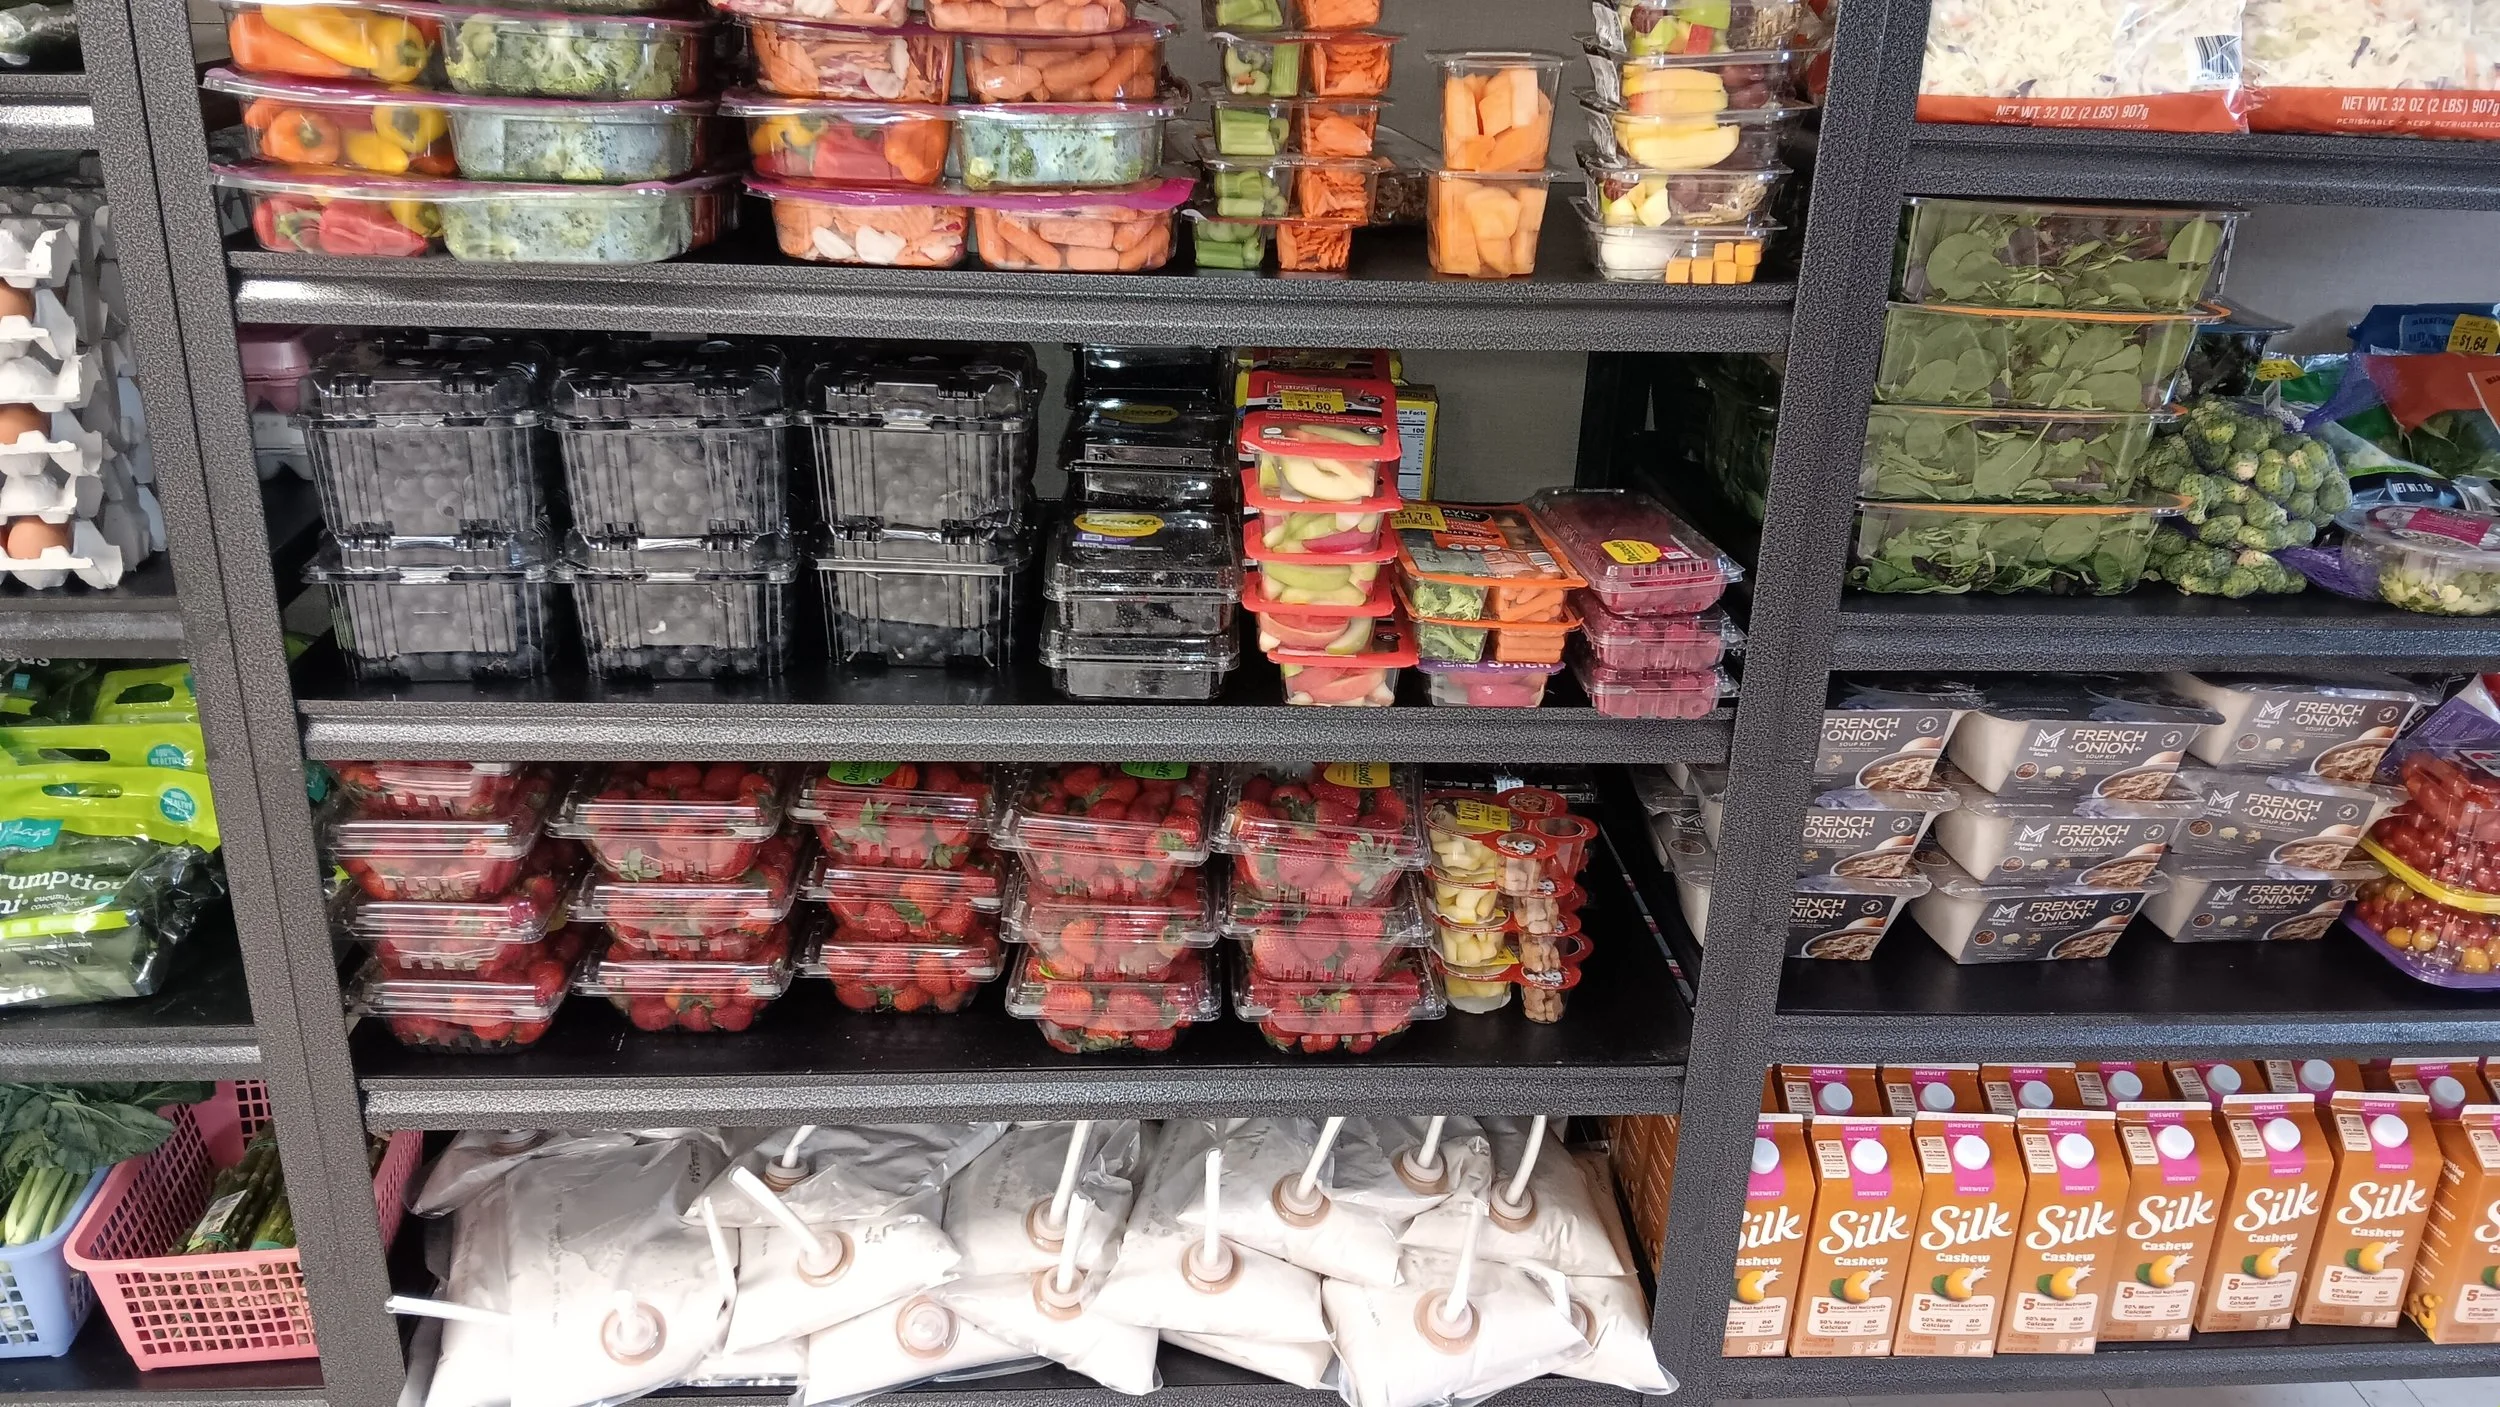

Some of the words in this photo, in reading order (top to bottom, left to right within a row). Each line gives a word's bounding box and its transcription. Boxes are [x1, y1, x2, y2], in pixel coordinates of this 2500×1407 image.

[1995, 105, 2019, 116] NET
[2020, 105, 2041, 119] WT.
[2043, 105, 2058, 119] 32
[2060, 106, 2077, 119] OZ
[2078, 105, 2093, 120] (2
[2093, 105, 2119, 120] LBS)
[2121, 104, 2149, 120] 907g
[2341, 95, 2365, 111] NET
[2367, 97, 2387, 112] WT.
[2391, 98, 2405, 112] 32
[2409, 98, 2424, 112] OZ
[2427, 98, 2439, 115] (2
[2441, 98, 2469, 116] LBS)
[2471, 99, 2500, 117] 907g
[2336, 117, 2395, 126] PERISHABLE
[2459, 334, 2488, 351] $1.64
[1296, 399, 1332, 411] $1.60
[2392, 483, 2406, 493] NET
[1442, 507, 1480, 519] aylor
[2295, 701, 2366, 717] FRENCH
[2383, 710, 2392, 719] 4
[1822, 717, 1900, 729] FRENCH
[1922, 720, 1931, 730] 4
[2296, 713, 2353, 727] ONION
[1827, 729, 1890, 741] ONION
[2072, 729, 2148, 743] FRENCH
[2167, 735, 2175, 744] 4
[2074, 741, 2136, 754] ONION
[2246, 793, 2323, 812] FRENCH
[2249, 805, 2310, 822] ONION
[2343, 808, 2352, 817] 4
[1897, 820, 1905, 829] 4
[2056, 824, 2130, 836] FRENCH
[1803, 827, 1864, 839] ONION
[2150, 828, 2158, 837] 4
[2059, 836, 2118, 847] ONION
[2247, 885, 2317, 895] FRENCH
[2334, 886, 2343, 894] 4
[1791, 898, 1846, 910] ENCH
[2029, 900, 2099, 912] FRENCH
[2117, 901, 2125, 909] 4
[2249, 895, 2305, 905] ONION
[1867, 903, 1875, 911] 4
[1789, 908, 1835, 920] NION
[2031, 910, 2087, 923] ONION
[2233, 1123, 2240, 1131] 5
[2340, 1117, 2347, 1125] 5
[2127, 1129, 2134, 1137] 5
[2473, 1133, 2481, 1141] 5
[1818, 1143, 1826, 1151] 5
[1920, 1139, 1928, 1147] 5
[2026, 1137, 2033, 1145] 5
[2233, 1183, 2320, 1232] Silk
[2336, 1180, 2428, 1225] Silk
[2126, 1191, 2216, 1239] Silk
[1818, 1206, 1910, 1255] Silk
[1920, 1202, 2013, 1250] Silk
[2025, 1201, 2117, 1250] Silk
[2247, 1233, 2299, 1243] Cashew
[2351, 1227, 2405, 1238] Cashew
[2141, 1242, 2194, 1251] Cashew
[1736, 1256, 1782, 1266] ashew
[1834, 1256, 1888, 1266] Cashew
[1936, 1252, 1991, 1263] Cashew
[2041, 1252, 2096, 1262] Cashew
[2330, 1271, 2343, 1283] 5
[2228, 1278, 2240, 1291] 5
[2122, 1286, 2134, 1299] 5
[2467, 1290, 2478, 1301] 5
[1817, 1301, 1830, 1314] 5
[1918, 1299, 1931, 1311] 5
[2023, 1298, 2036, 1310] 5
